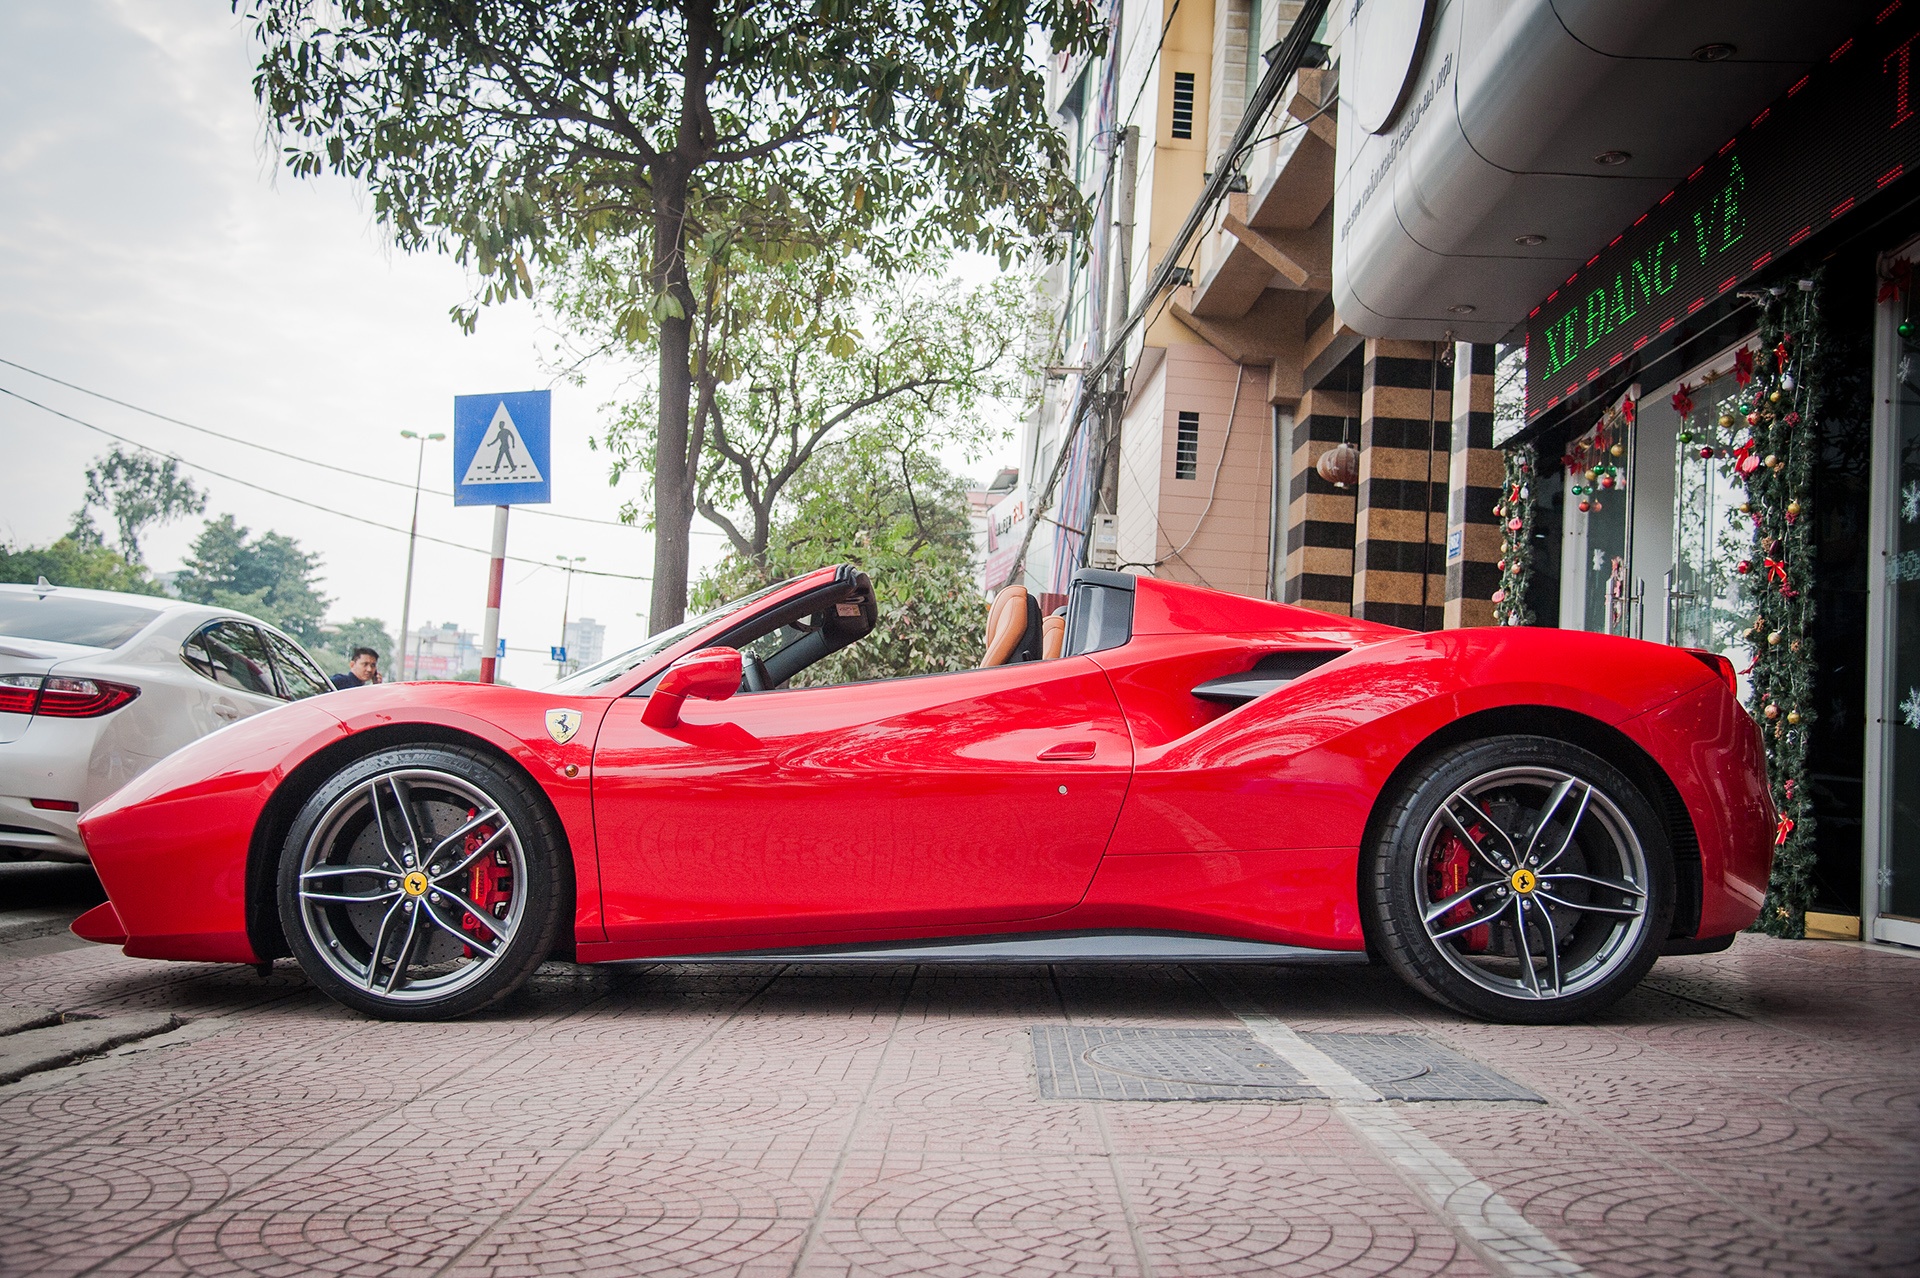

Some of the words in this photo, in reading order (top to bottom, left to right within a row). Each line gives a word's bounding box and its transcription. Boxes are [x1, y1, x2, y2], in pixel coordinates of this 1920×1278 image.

[1436, 53, 1453, 94] NỘI
[1543, 307, 1578, 380] XE
[1584, 227, 1680, 349] ĐANG
[1692, 155, 1746, 265] VỀ
[412, 752, 473, 774] MICHELIN
[1507, 745, 1539, 754] Sport
